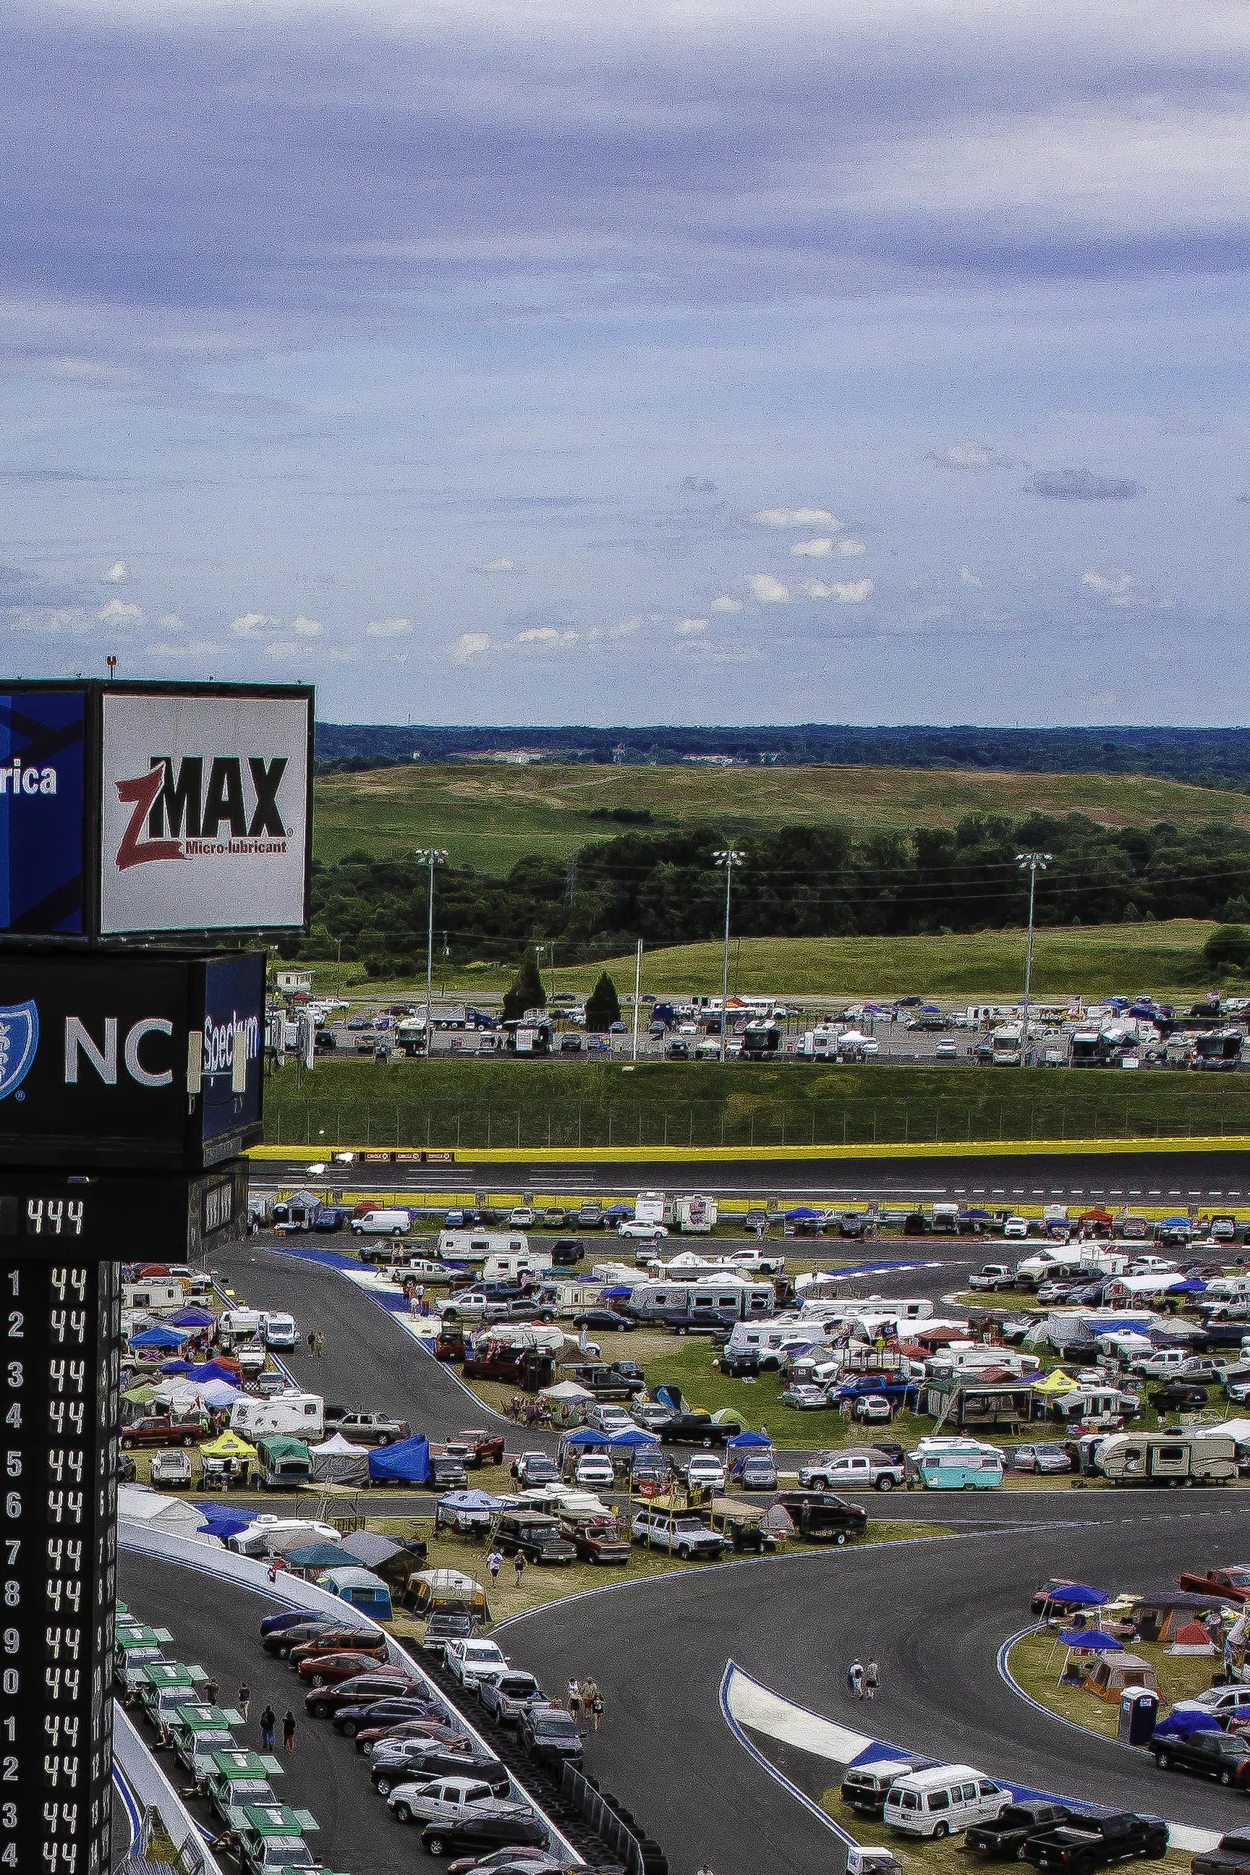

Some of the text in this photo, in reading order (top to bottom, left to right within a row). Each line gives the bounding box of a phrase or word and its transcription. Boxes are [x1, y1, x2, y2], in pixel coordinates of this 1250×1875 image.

[65, 1016, 173, 1087] NC
[28, 1200, 83, 1234] 444
[8, 1268, 86, 1301] 1 44
[8, 1310, 85, 1343] 2 44
[8, 1360, 84, 1392] 3 44
[6, 1401, 84, 1434] 4 44
[7, 1450, 83, 1482] 5 44
[6, 1491, 83, 1523] 6 44
[6, 1539, 82, 1571] 7 44
[5, 1580, 81, 1612] 8 44
[3, 1627, 80, 1659] 9 44
[46, 1668, 79, 1700] 44
[45, 1715, 78, 1747] 44
[45, 1755, 78, 1787] 44
[44, 1803, 77, 1833] 44
[43, 1842, 77, 1873] 44
